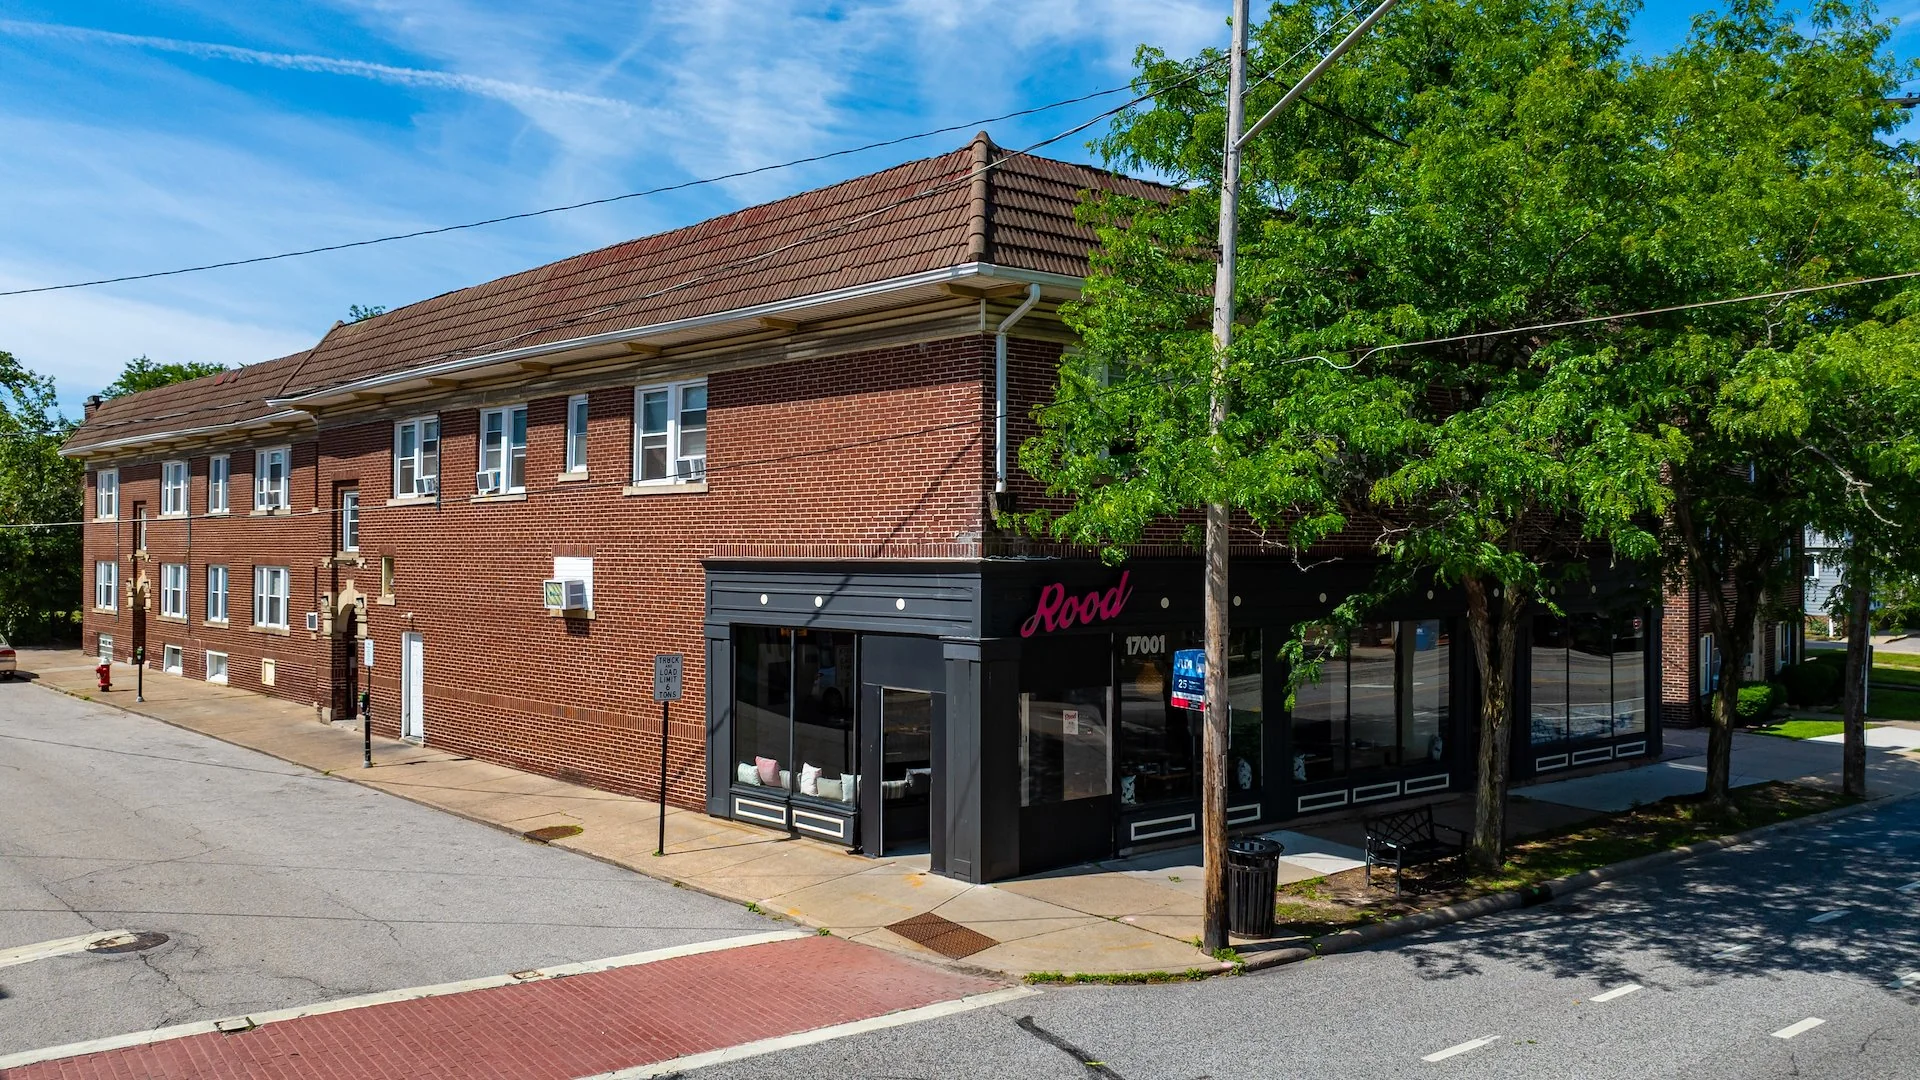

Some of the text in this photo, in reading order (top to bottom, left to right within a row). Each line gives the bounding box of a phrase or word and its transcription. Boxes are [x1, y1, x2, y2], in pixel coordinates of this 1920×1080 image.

[1020, 570, 1133, 638] Rood
[1126, 635, 1166, 656] 17001
[1178, 679, 1188, 689] 25
